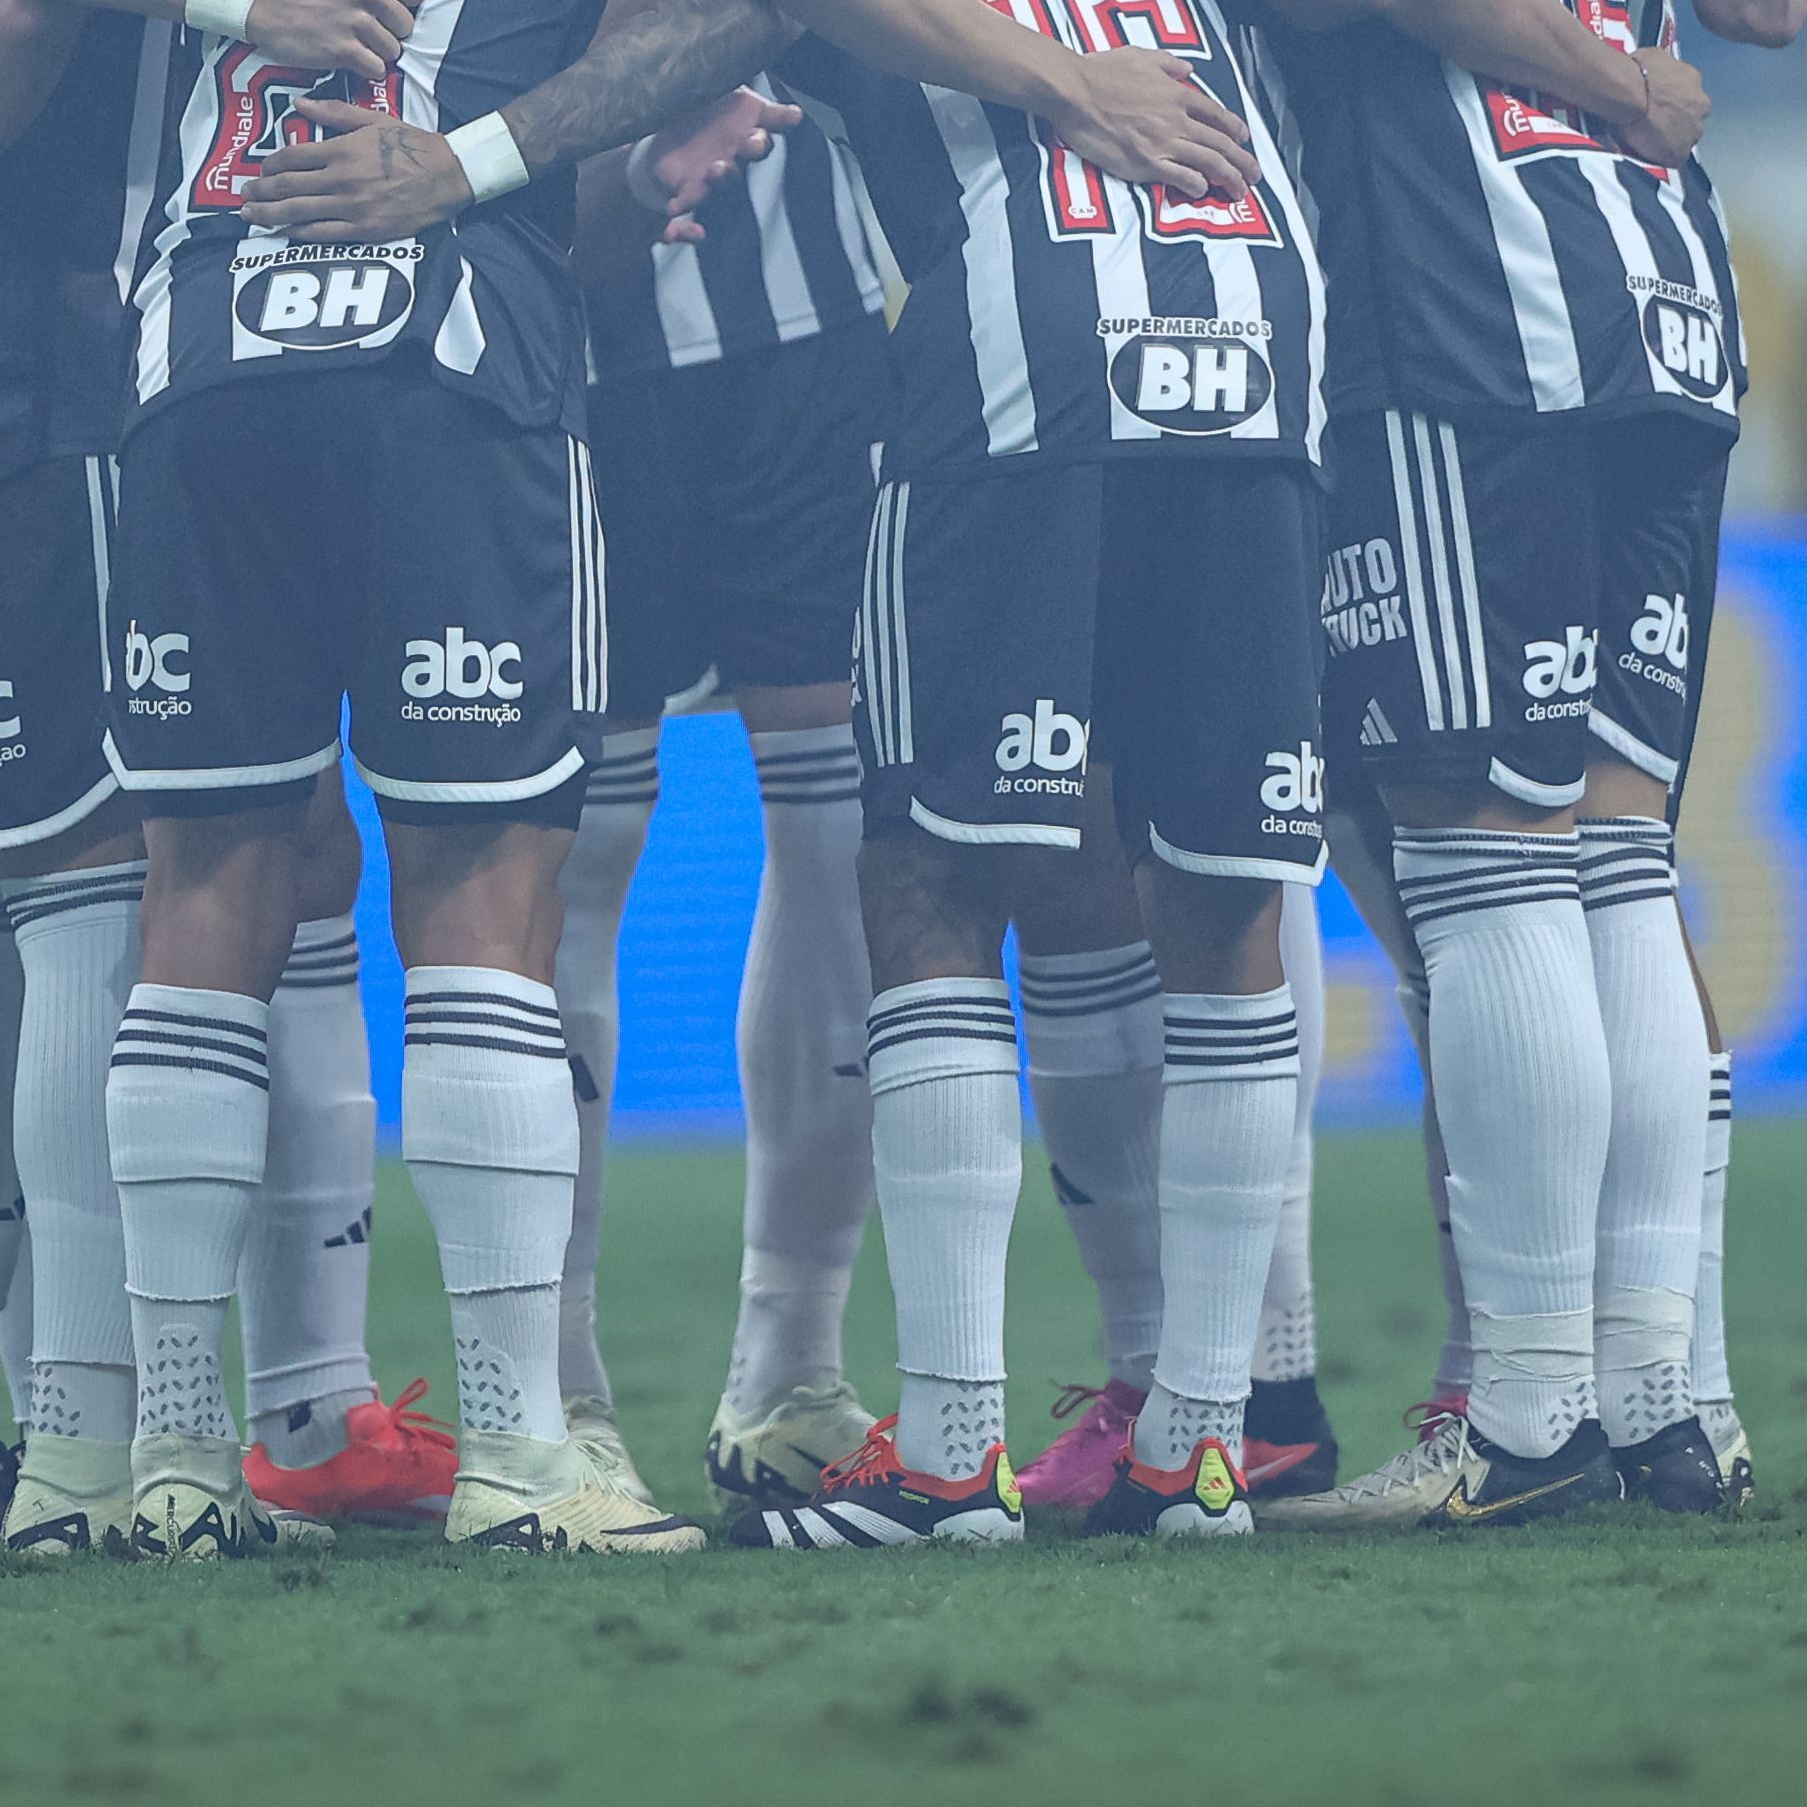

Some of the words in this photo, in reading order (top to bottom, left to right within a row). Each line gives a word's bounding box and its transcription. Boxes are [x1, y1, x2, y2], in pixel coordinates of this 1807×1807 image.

[205, 95, 254, 192] mundiale
[231, 244, 425, 272] SUPERMERCADOS
[258, 267, 390, 332] BH
[1096, 317, 1274, 338] SUPERMERCADOS
[1656, 303, 1718, 386] BH
[1136, 345, 1249, 413] BH
[125, 619, 191, 692] bc
[1321, 594, 1409, 657] RUCK
[401, 626, 523, 700] abc
[1522, 625, 1599, 699] ab
[1618, 651, 1643, 675] da
[400, 700, 425, 721] da
[427, 702, 522, 728] construção
[995, 699, 1091, 776] ab
[1524, 702, 1547, 722] da
[993, 775, 1012, 794] da
[1260, 814, 1287, 834] da
